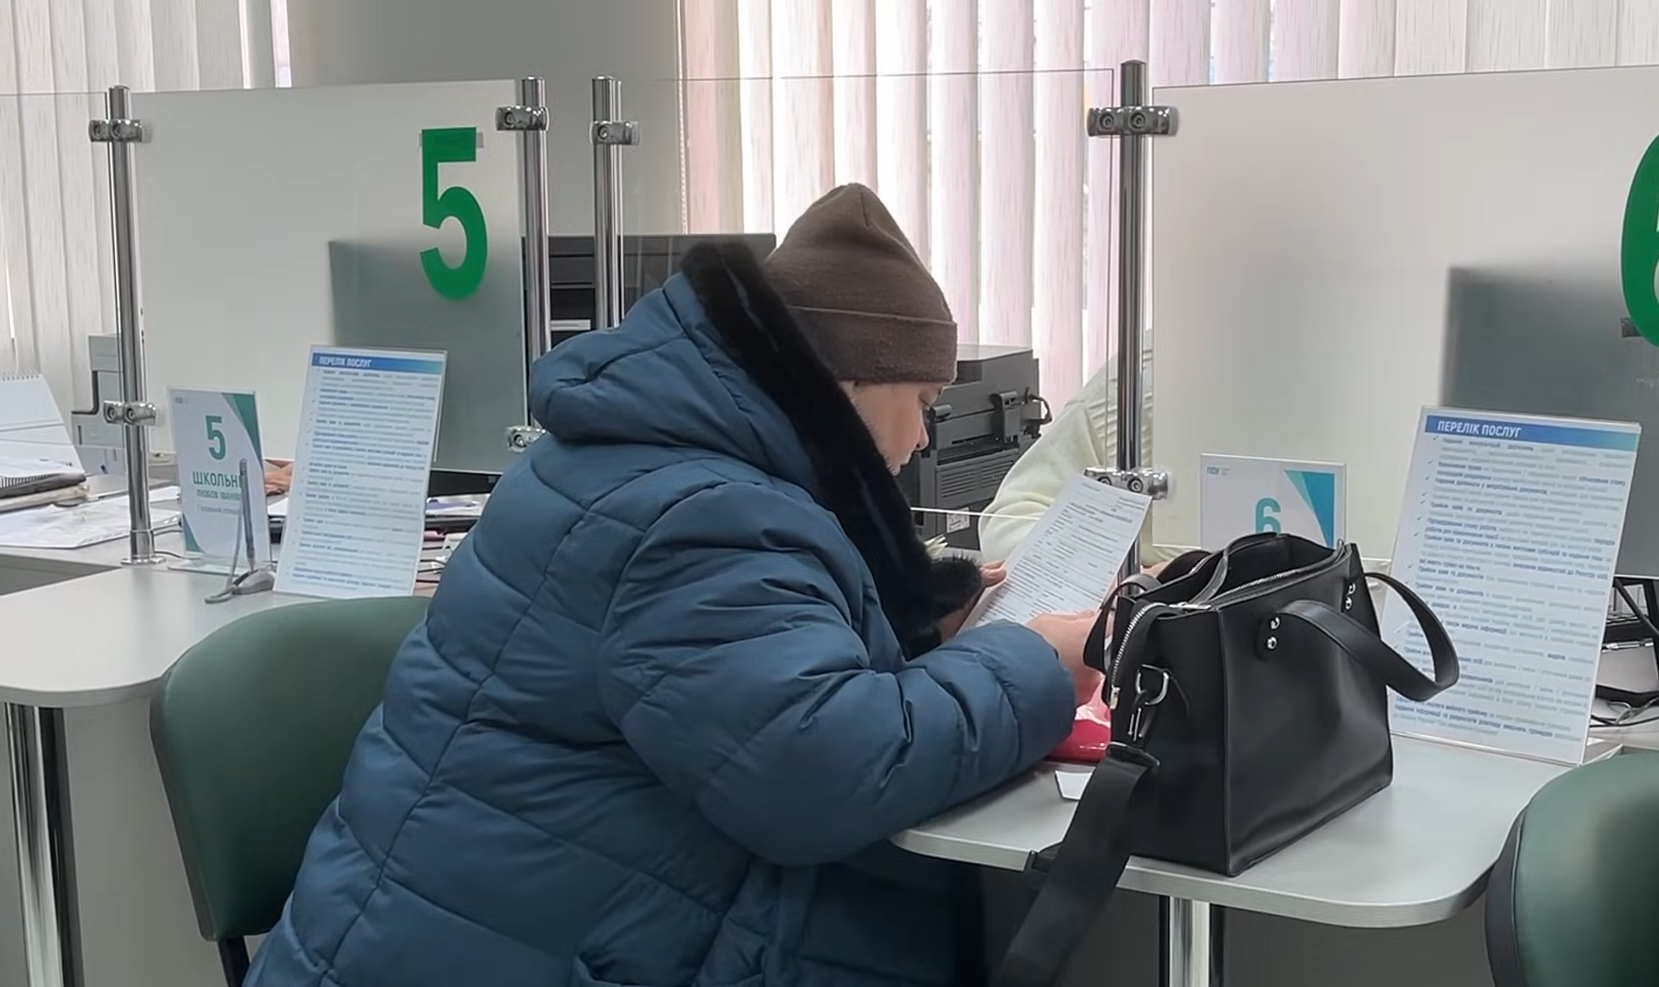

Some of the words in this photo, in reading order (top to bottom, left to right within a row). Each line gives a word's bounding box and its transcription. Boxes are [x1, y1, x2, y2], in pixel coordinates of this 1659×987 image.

[420, 127, 488, 302] 5
[319, 356, 346, 367] ПЕРЕЛІК
[347, 358, 372, 369] ПОСЛУГ
[205, 415, 226, 460] 5
[1437, 420, 1479, 435] ПЕРЕЛІК
[1481, 424, 1522, 439] ПОСЛУГ
[1255, 497, 1281, 535] 6
